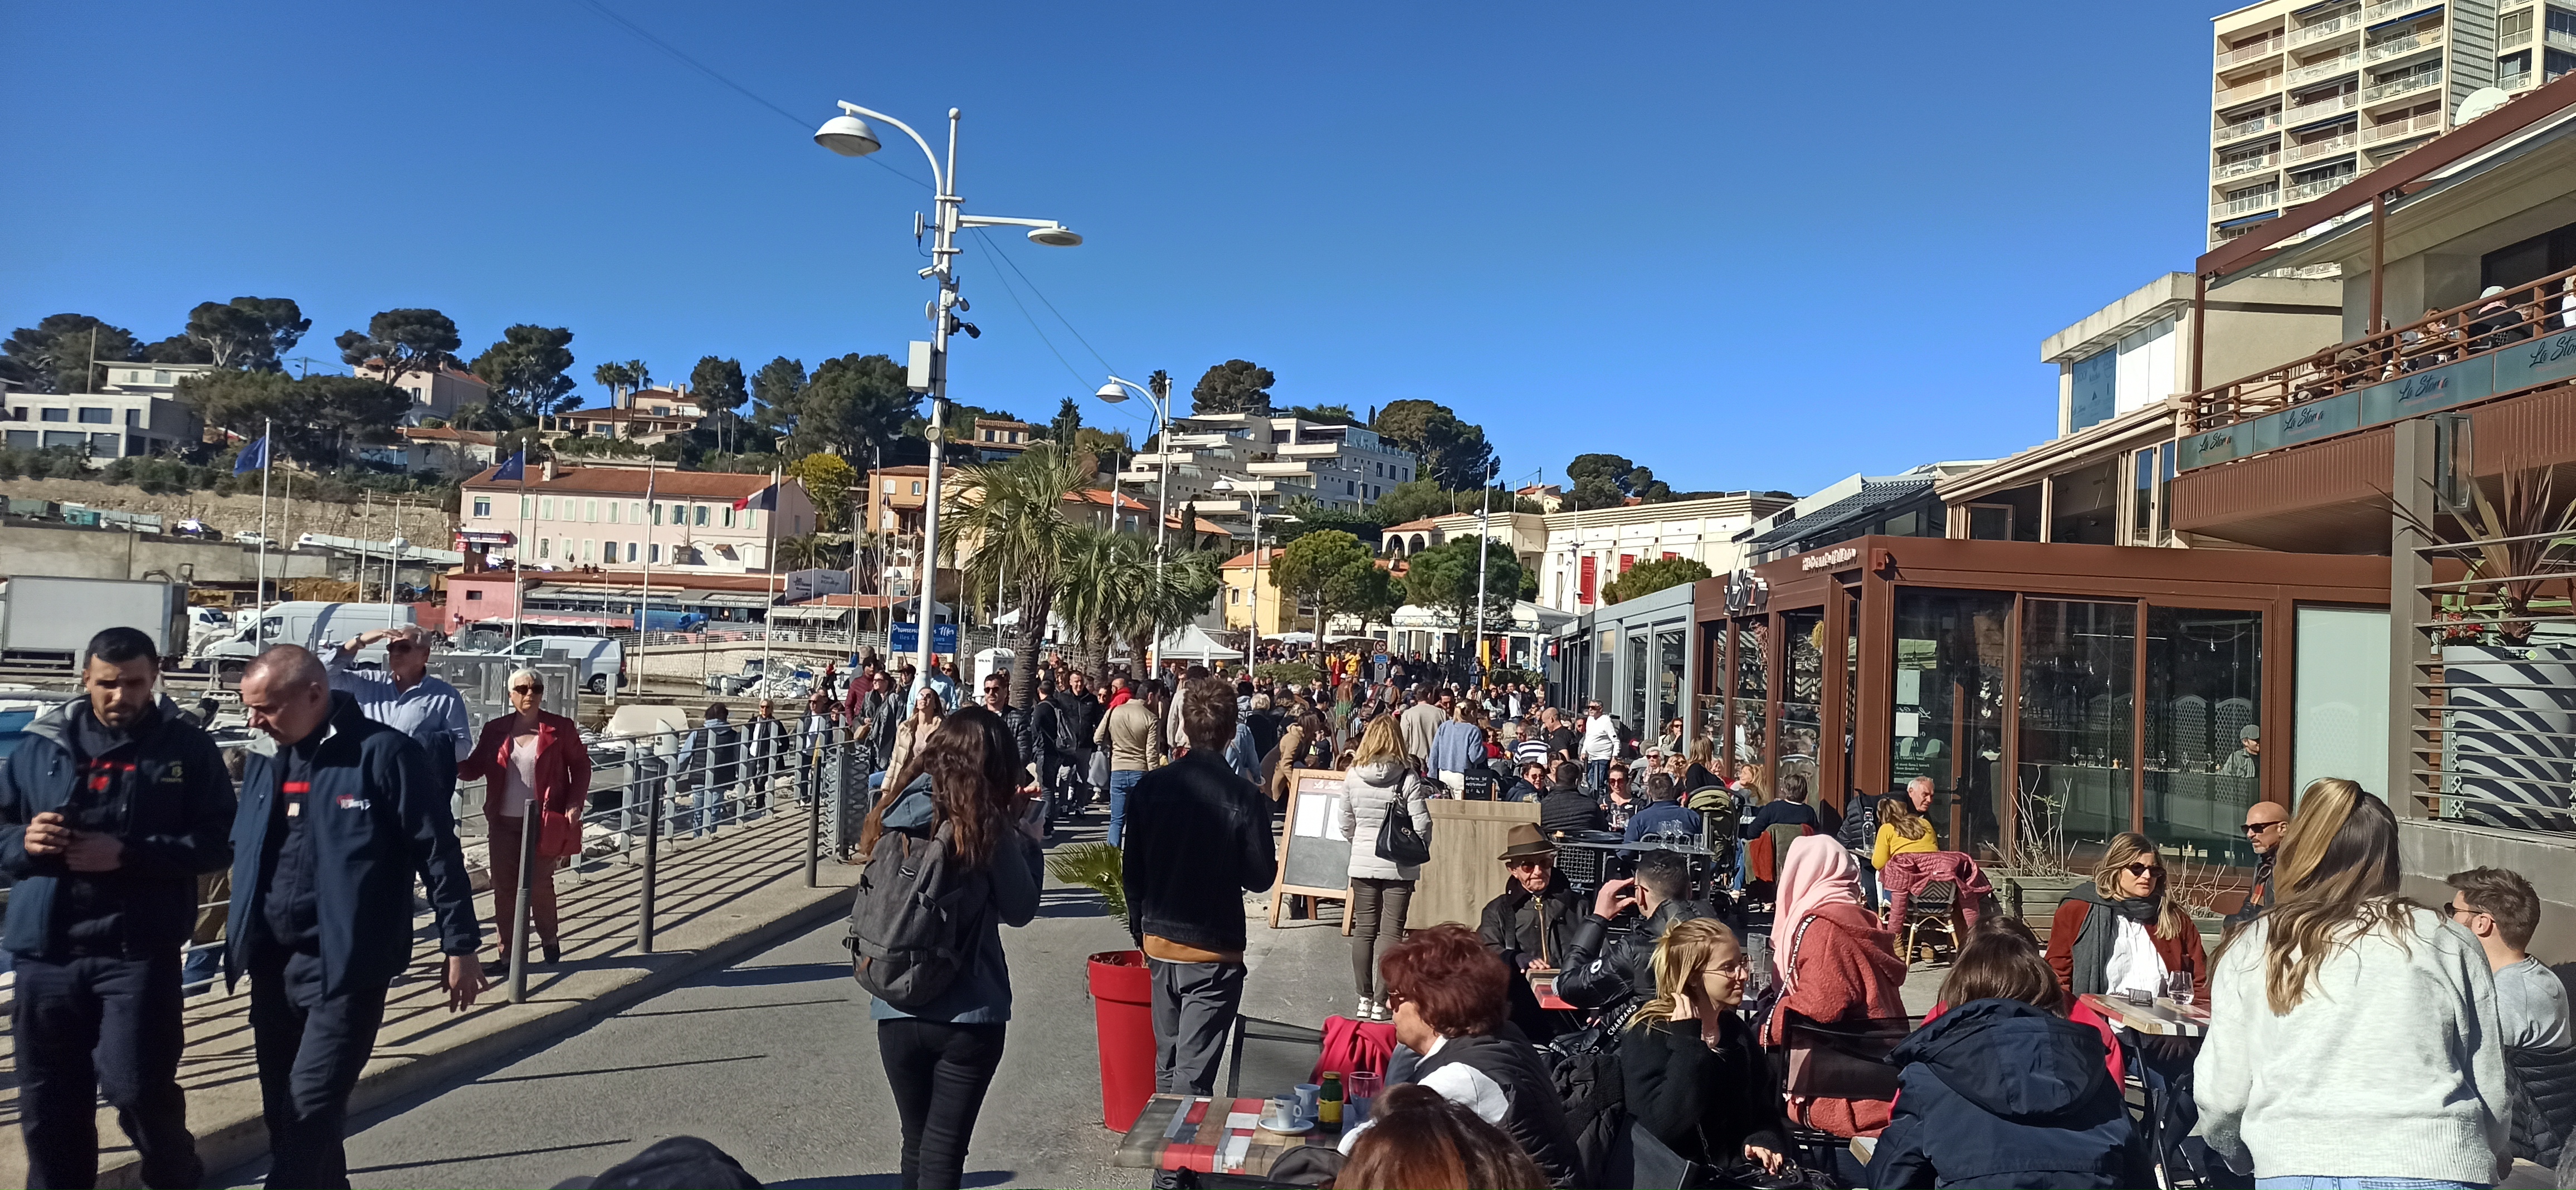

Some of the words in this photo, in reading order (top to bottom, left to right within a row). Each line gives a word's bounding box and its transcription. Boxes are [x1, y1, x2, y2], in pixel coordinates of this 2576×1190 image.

[2529, 341, 2547, 368] La
[2398, 379, 2413, 402] La
[2415, 374, 2450, 397] Storia
[2284, 411, 2296, 431] La
[2297, 407, 2324, 427] Storia
[2199, 435, 2209, 454] La
[2209, 432, 2232, 450] Storia
[1793, 921, 1809, 953] BEAUTIFUL
